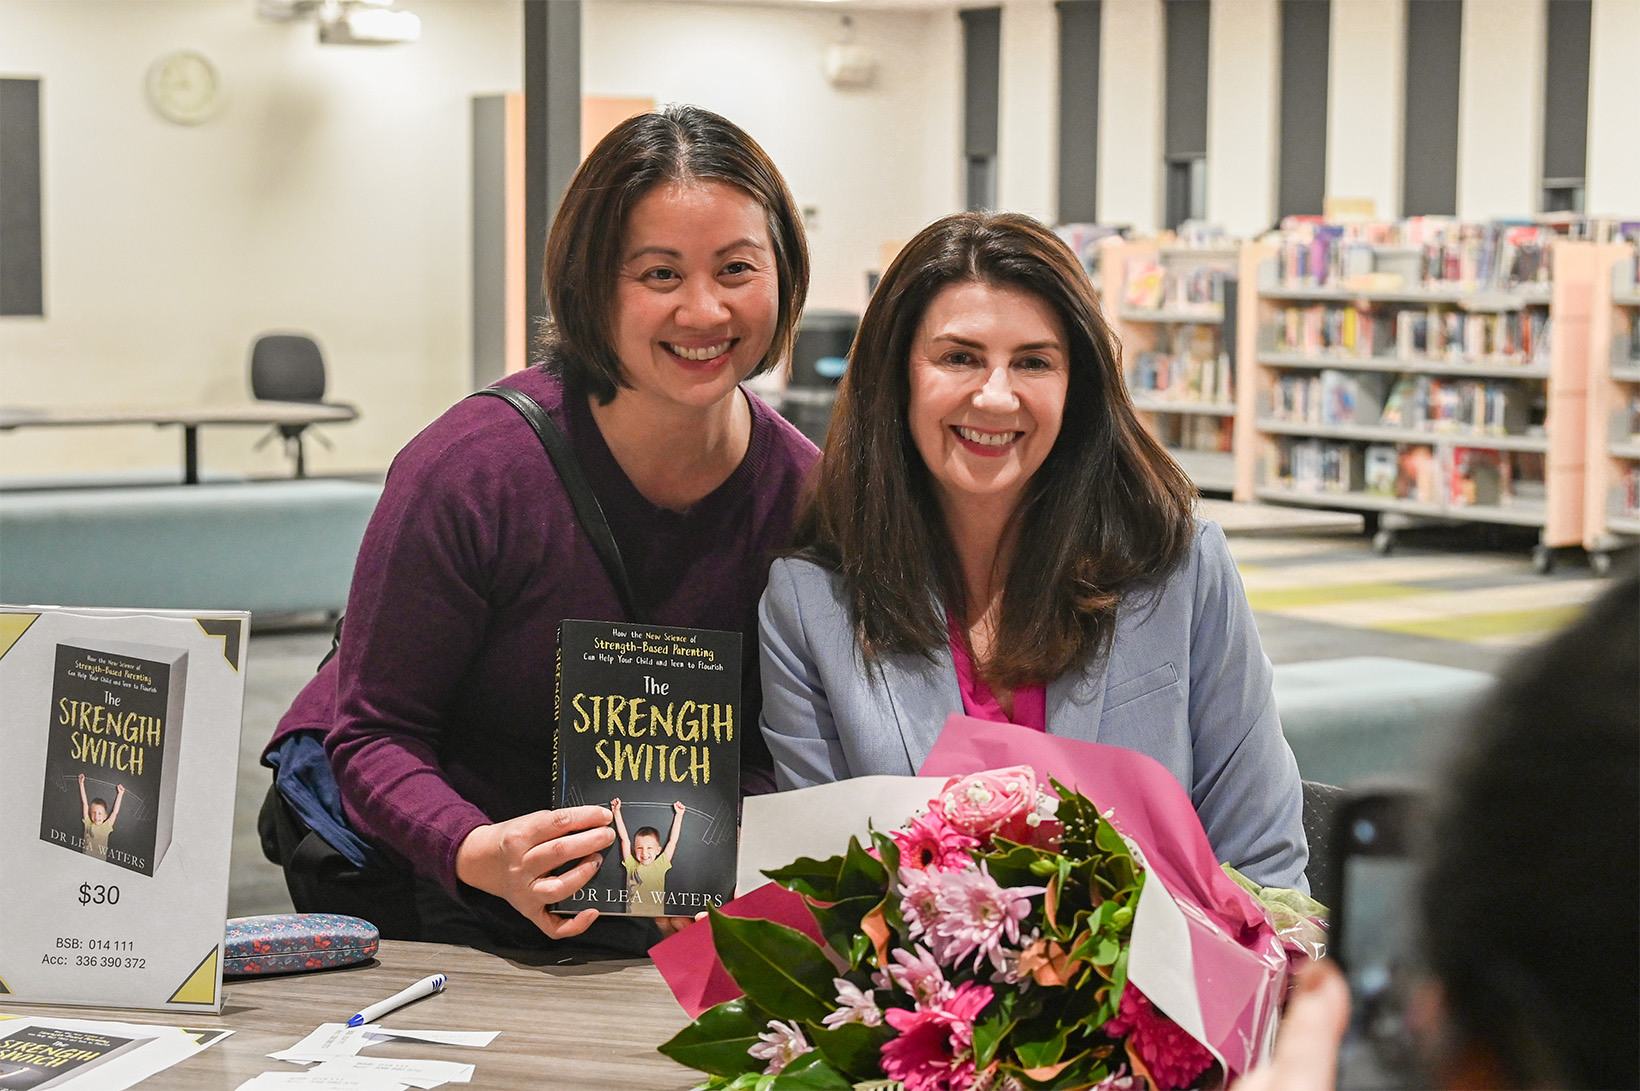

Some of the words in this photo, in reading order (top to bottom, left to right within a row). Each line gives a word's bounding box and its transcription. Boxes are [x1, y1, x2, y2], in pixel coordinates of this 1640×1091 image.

[612, 628, 627, 637] How
[646, 632, 661, 640] New
[664, 632, 687, 642] Science
[690, 635, 697, 643] of
[594, 637, 668, 655] Strength-Based
[673, 644, 714, 662] Parenting
[583, 652, 596, 660] Can
[599, 653, 614, 664] Help
[618, 655, 632, 664] Your
[636, 656, 653, 666] Child
[698, 661, 724, 671] Flourish
[643, 676, 670, 695] The
[104, 690, 121, 706] The
[59, 697, 161, 747] STRENGTH
[572, 692, 734, 744] STRENGTH
[70, 731, 144, 776] SWITCH
[595, 739, 710, 787] SWITCH
[50, 828, 67, 843] DR
[70, 835, 93, 852] LEA
[98, 844, 145, 869] WATERS
[78, 881, 120, 906] $30
[572, 888, 598, 902] DR
[606, 889, 643, 904] LEA
[650, 890, 723, 908] WATERS
[56, 938, 82, 950] BSB:
[88, 939, 110, 950] 014
[114, 940, 134, 951] 111
[41, 954, 68, 966] Acc:
[76, 955, 98, 966] 336
[100, 956, 122, 968] 390
[124, 958, 146, 969] 372
[0, 1040, 100, 1061] STRENGTH
[0, 1050, 68, 1068] SWITCH
